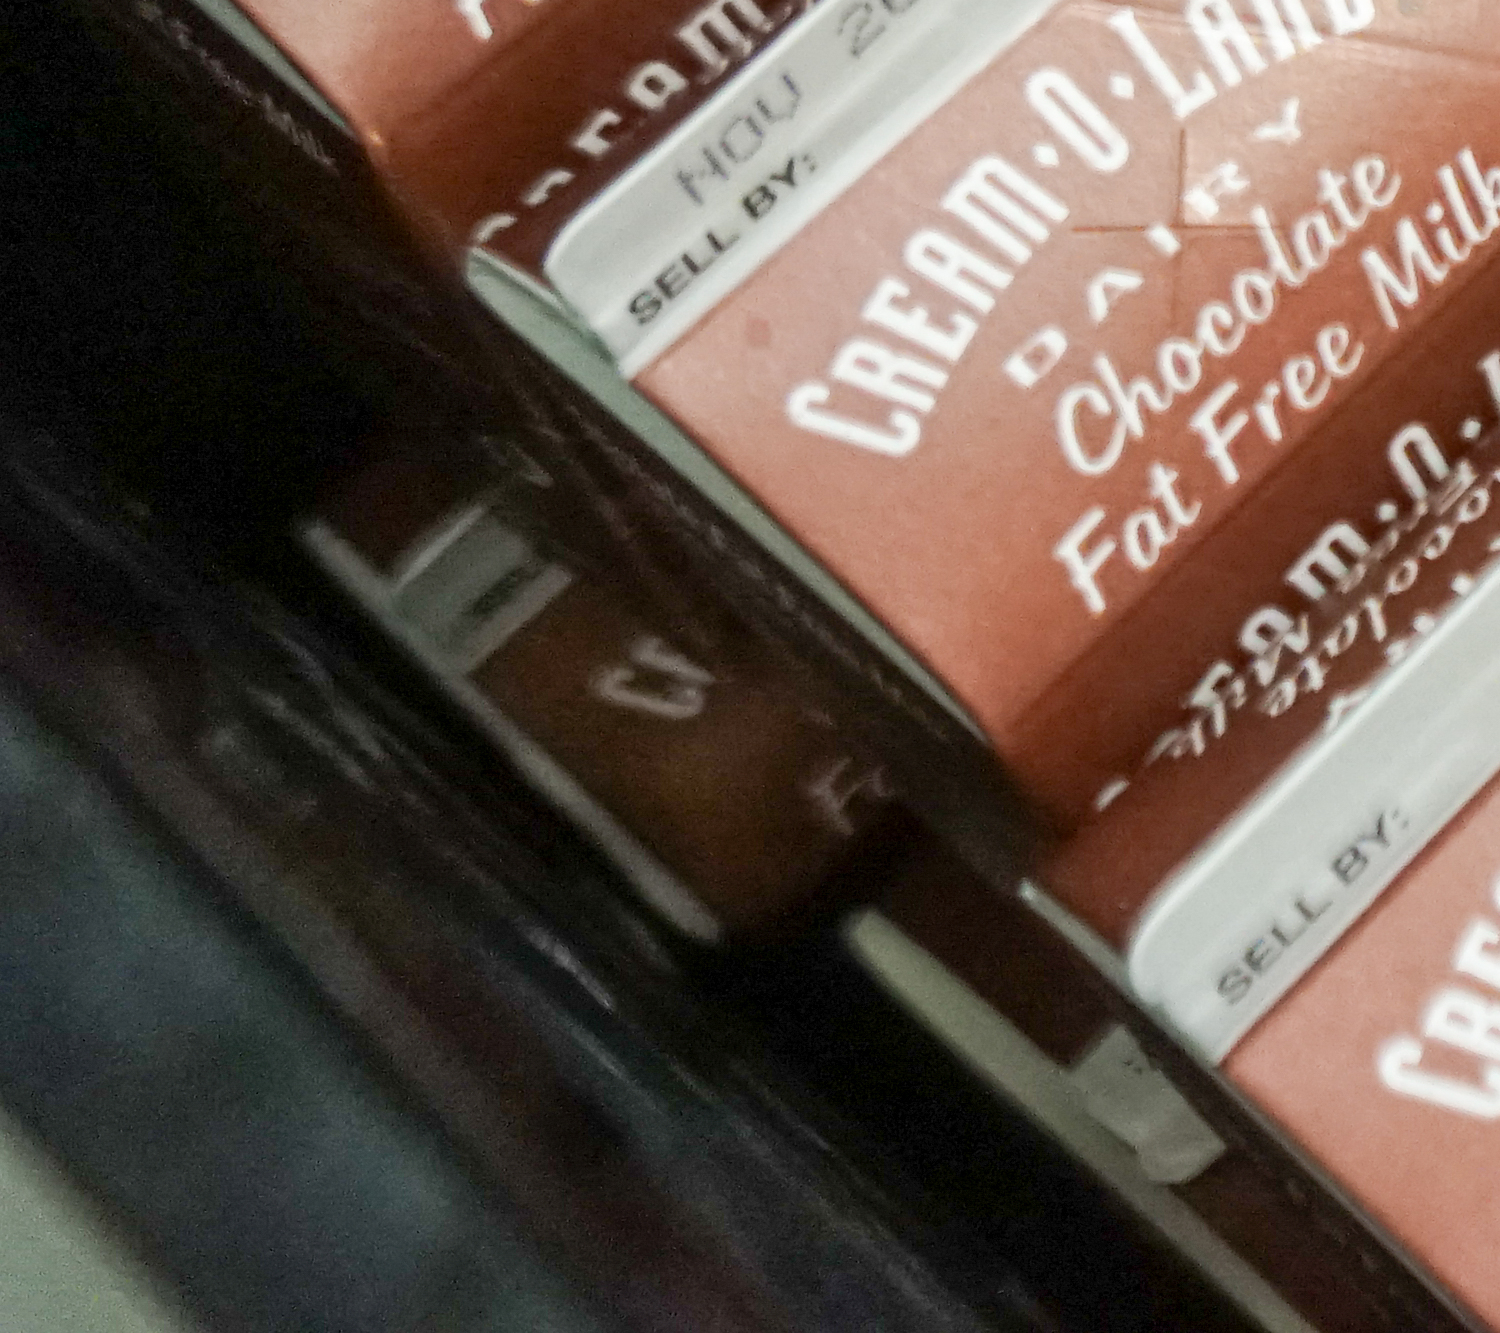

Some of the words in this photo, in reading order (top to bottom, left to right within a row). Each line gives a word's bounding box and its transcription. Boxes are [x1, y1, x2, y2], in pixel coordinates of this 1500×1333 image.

[627, 228, 737, 327] SELL
[741, 149, 817, 223] BY:
[1057, 154, 1400, 477] Chocolate
[1055, 465, 1203, 616] Fat
[1190, 330, 1364, 483] Free
